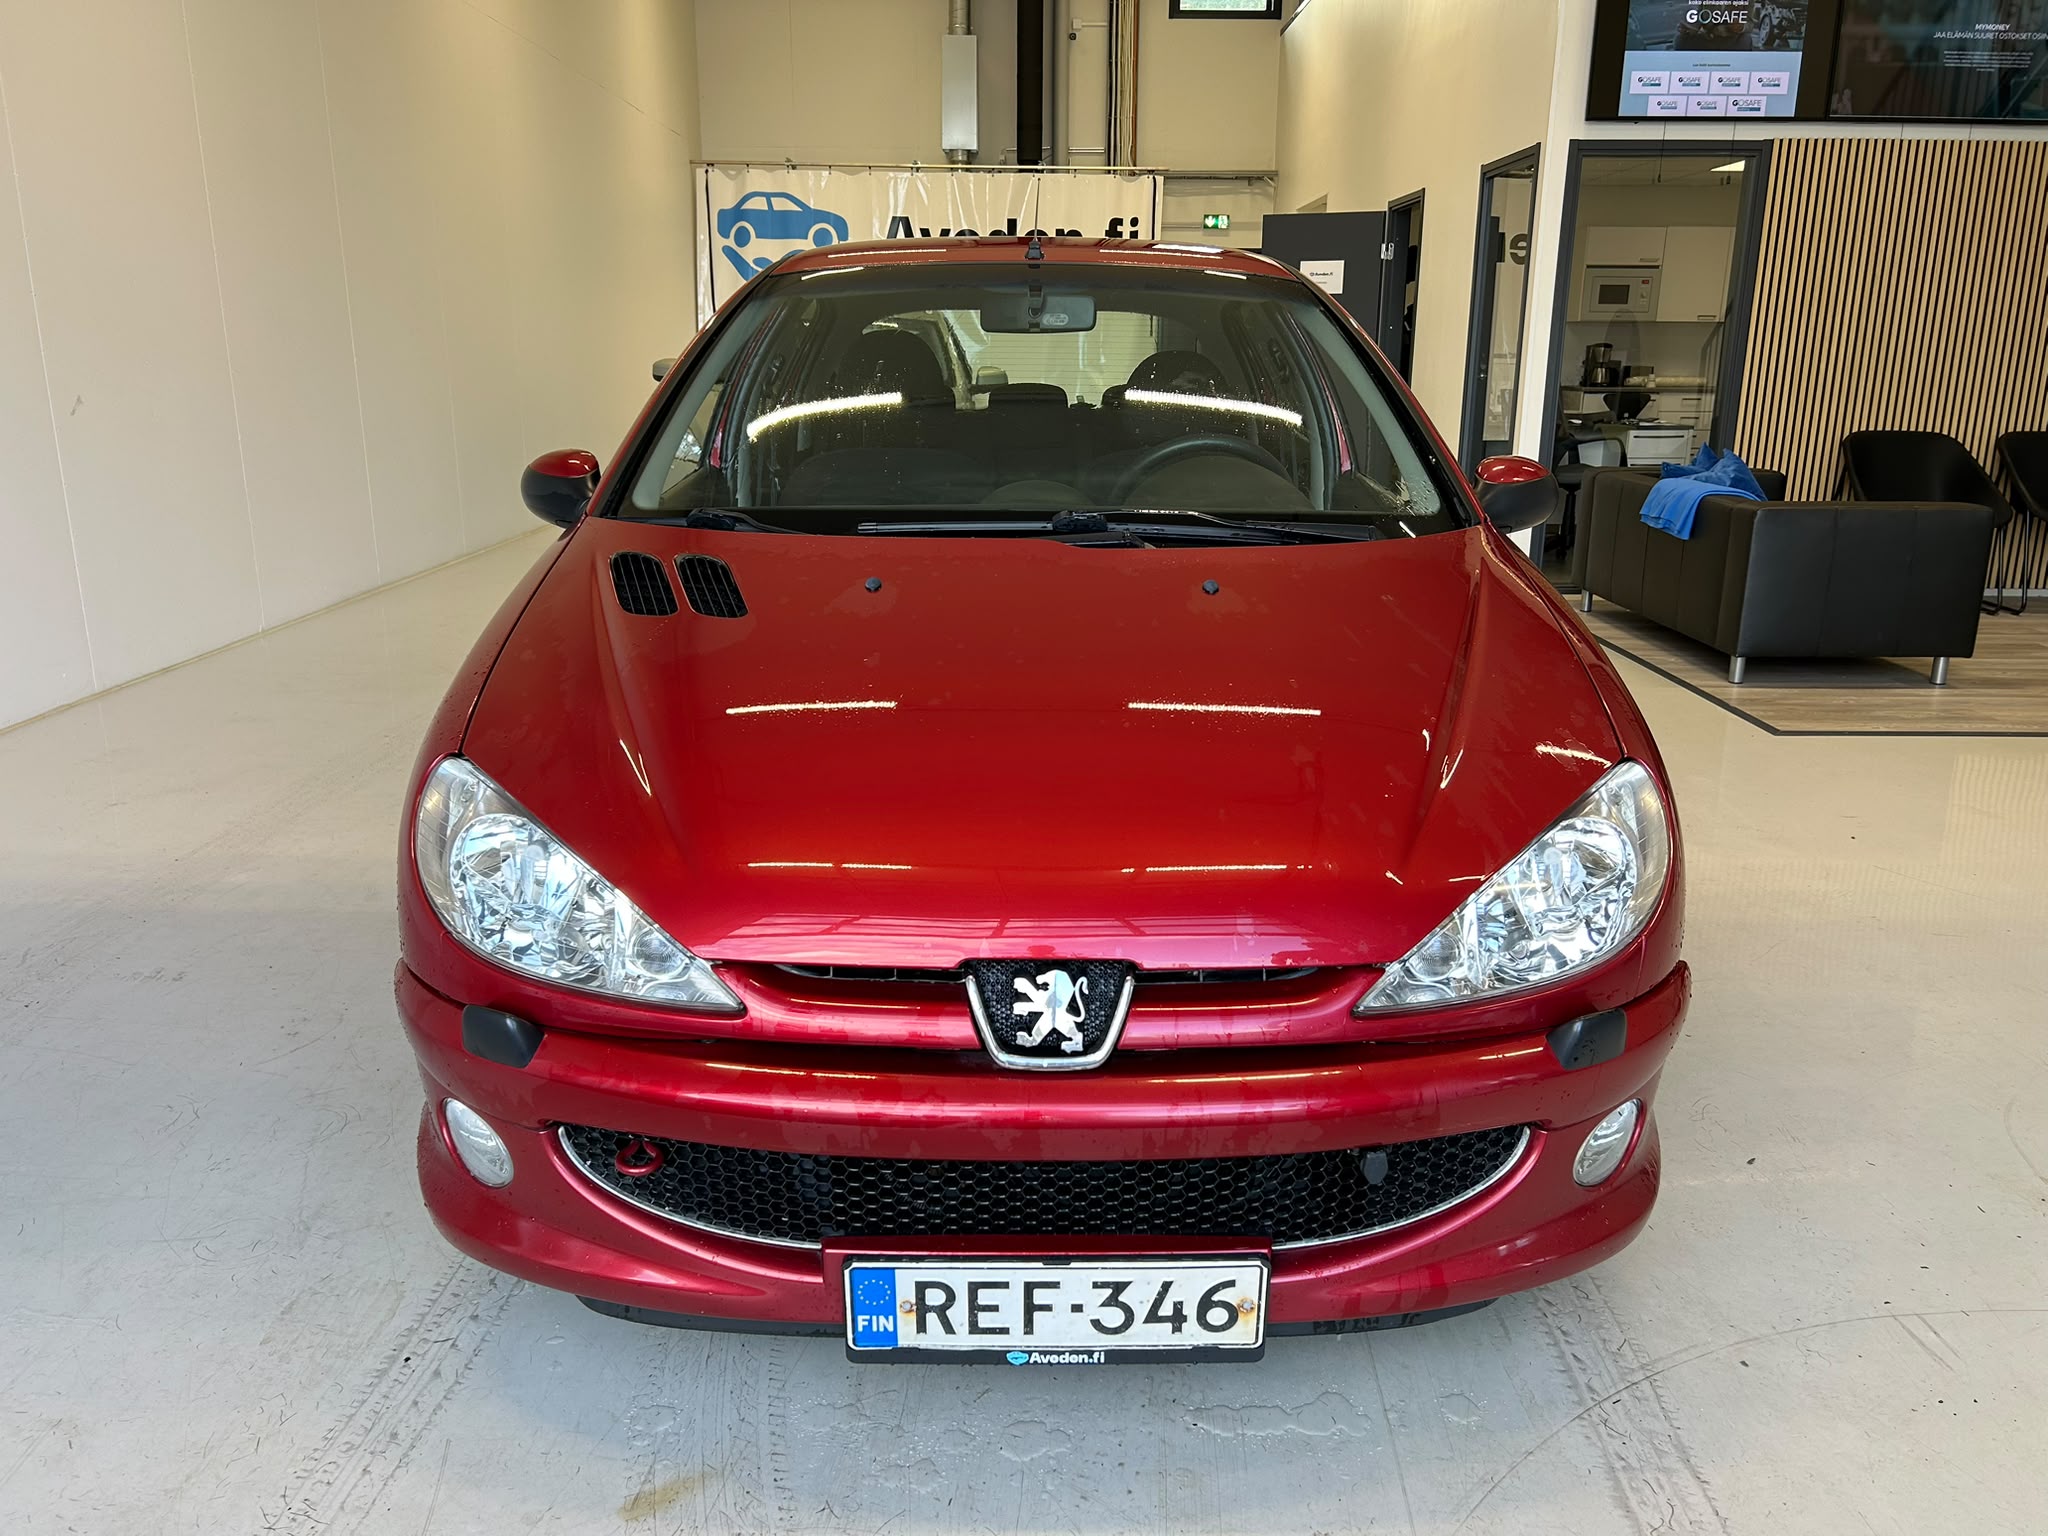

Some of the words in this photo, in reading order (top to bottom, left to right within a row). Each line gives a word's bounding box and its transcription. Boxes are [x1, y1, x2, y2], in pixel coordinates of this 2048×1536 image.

[1686, 10, 1748, 23] GOSAFE
[914, 1279, 1239, 1335] REF-346
[857, 1315, 894, 1332] FIN
